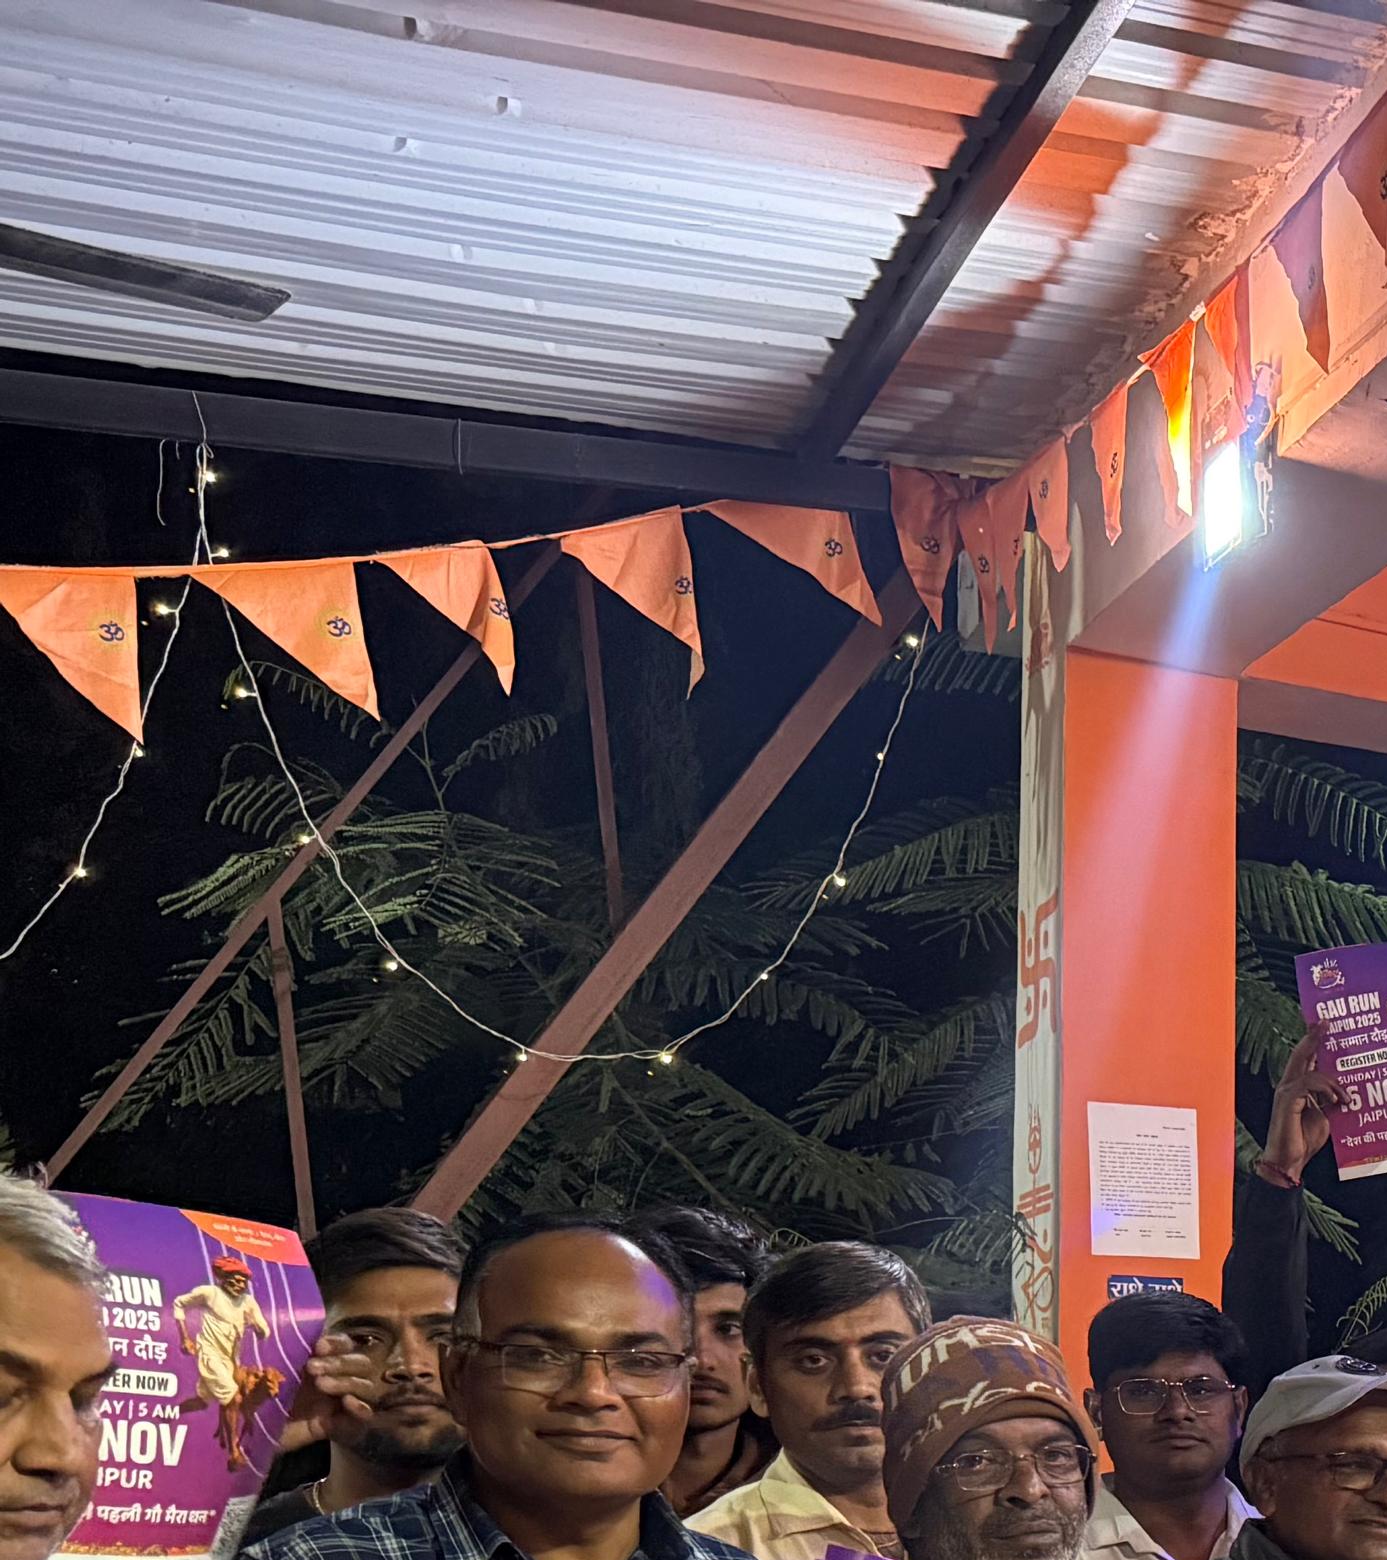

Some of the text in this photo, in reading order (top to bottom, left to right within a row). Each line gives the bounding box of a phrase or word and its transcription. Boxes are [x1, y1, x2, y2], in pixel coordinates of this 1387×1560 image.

[1316, 992, 1380, 1019] GAU RUN
[113, 1308, 161, 1332] 2025
[134, 1336, 168, 1365] दौड़
[136, 1375, 169, 1392] NOW
[138, 1402, 180, 1420] 5 AM
[100, 1421, 187, 1467] NOV
[96, 1469, 153, 1489] IPUR
